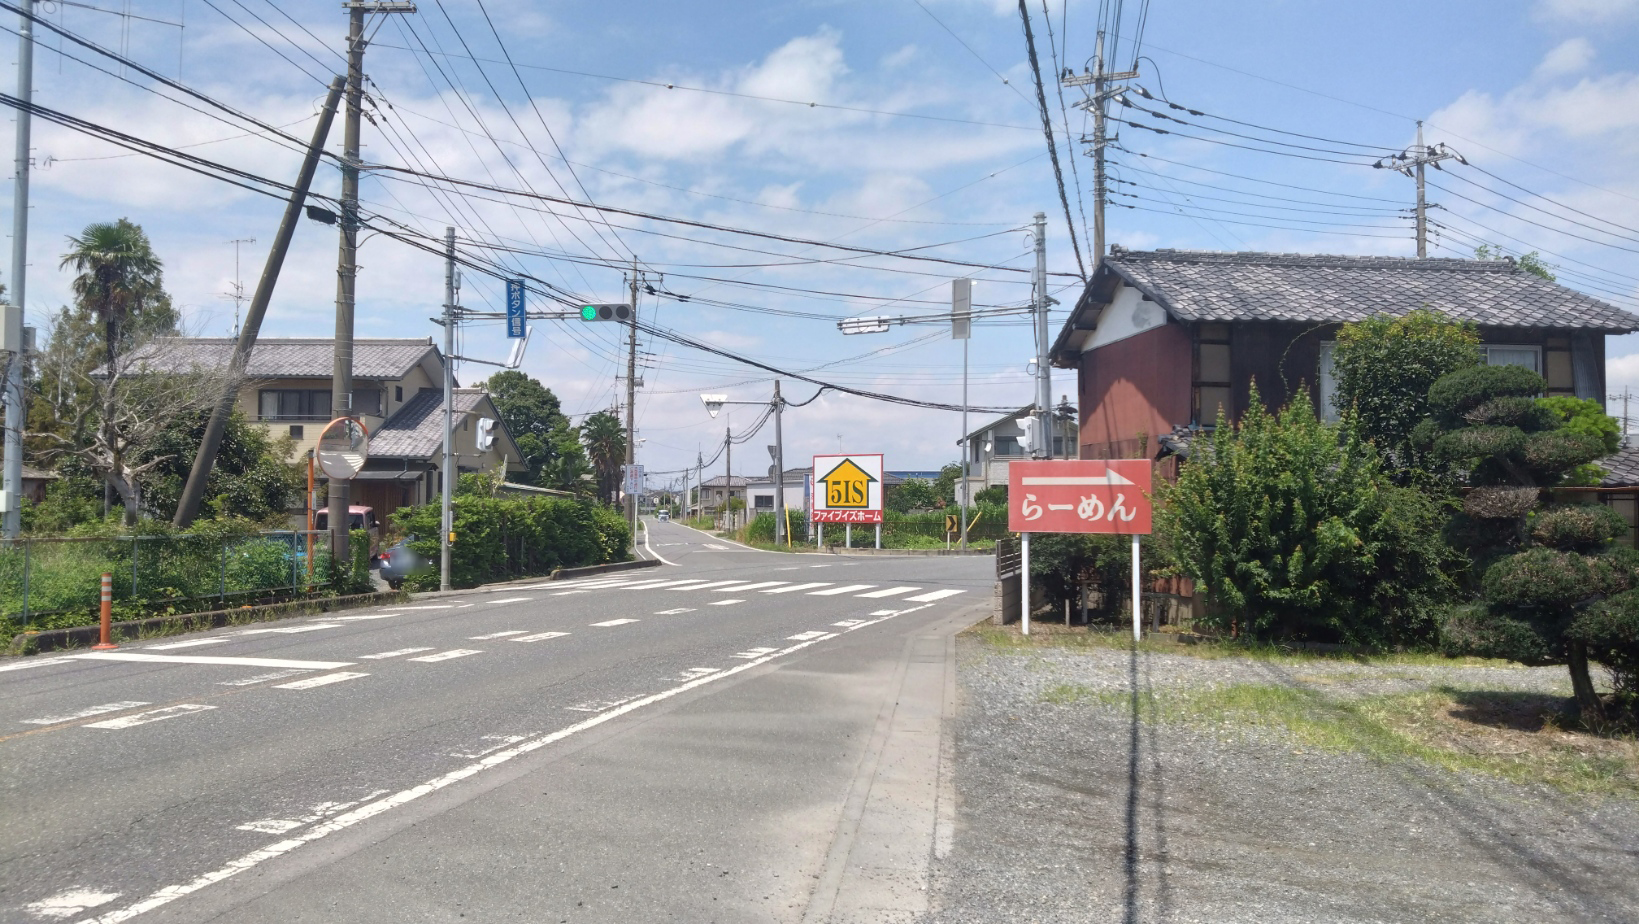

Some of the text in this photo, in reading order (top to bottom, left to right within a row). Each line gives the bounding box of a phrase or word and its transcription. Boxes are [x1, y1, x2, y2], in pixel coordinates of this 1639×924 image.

[813, 510, 882, 522] ファイブイズホーム
[1022, 493, 1137, 522] らーめん
